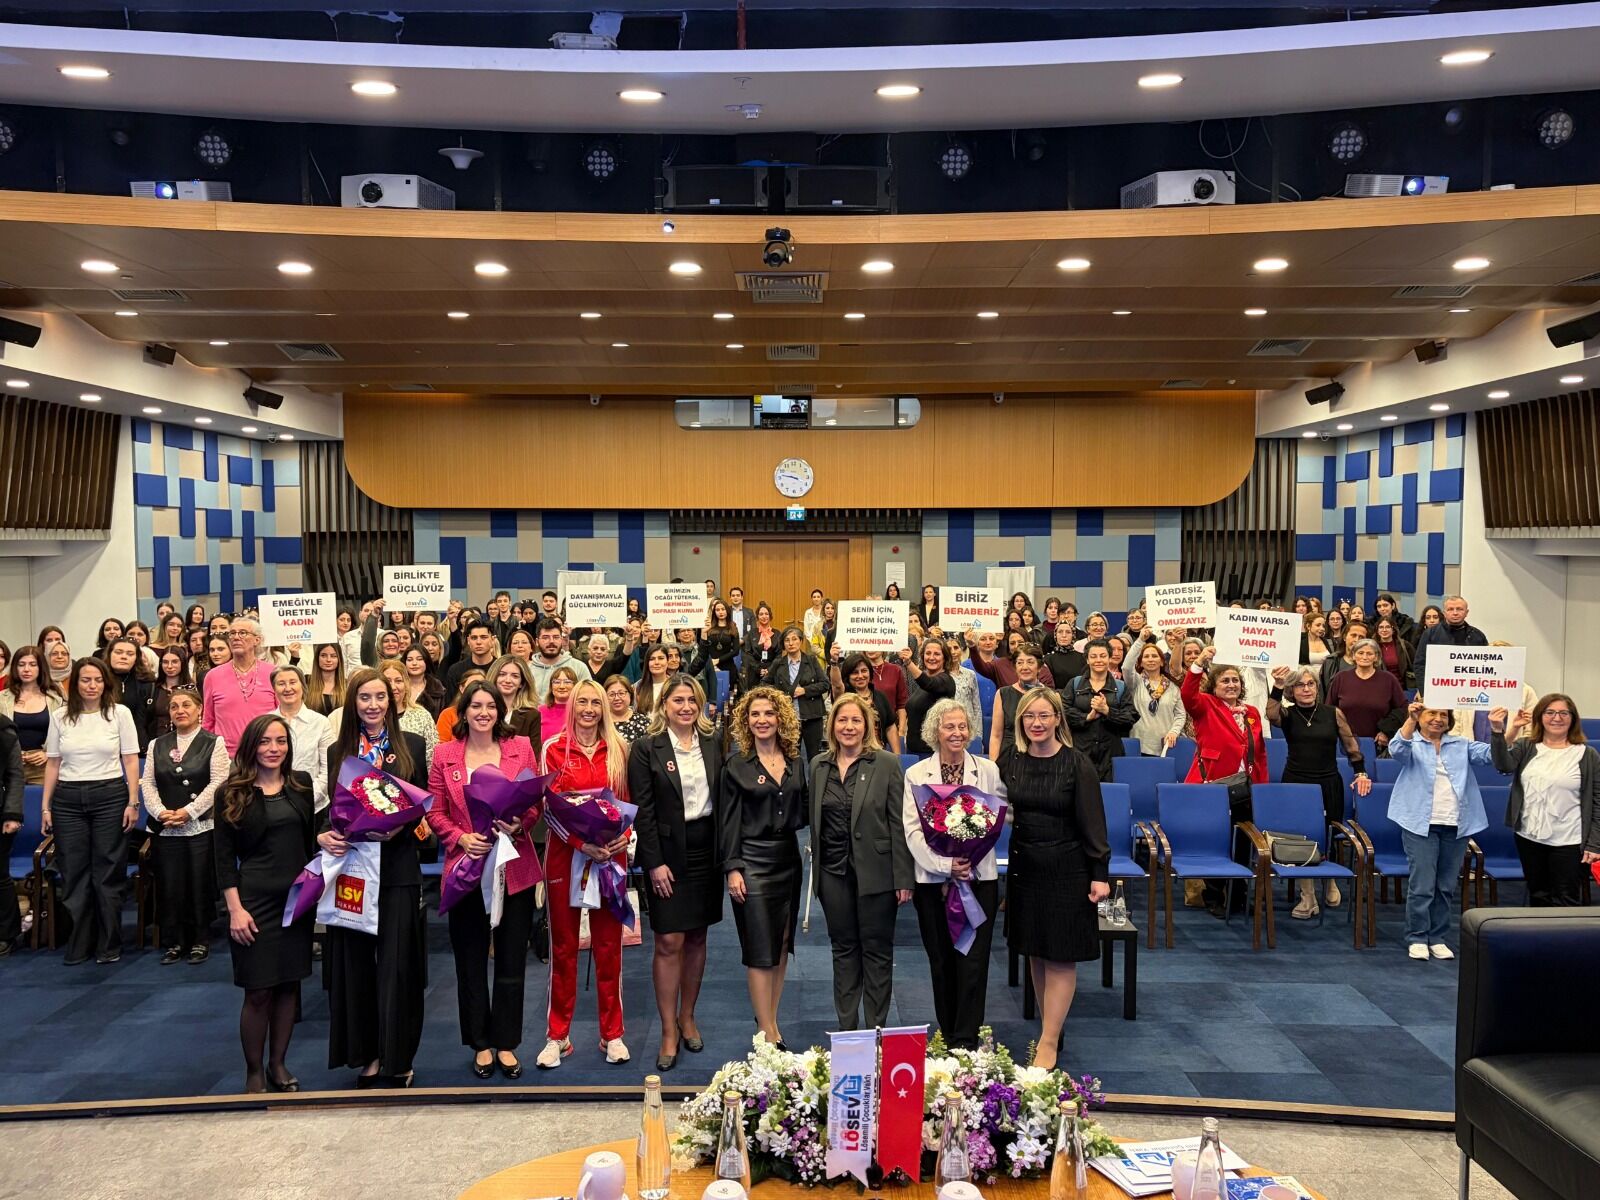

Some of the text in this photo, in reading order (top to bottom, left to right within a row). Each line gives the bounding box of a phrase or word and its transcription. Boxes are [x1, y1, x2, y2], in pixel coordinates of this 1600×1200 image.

[394, 570, 440, 580] BİRLİKTE
[390, 583, 444, 594] GÜÇLÜYÜZ
[1155, 585, 1206, 596] KARDEŞİZ,
[272, 596, 322, 607] EMEĞİYLE
[956, 591, 988, 602] BİRİZ
[1156, 596, 1206, 606] YOLDAŞIZ,
[278, 608, 318, 616] ÜRETEN
[877, 605, 894, 614] İÇİN,
[944, 607, 999, 616] BERABERİZ
[1168, 607, 1196, 615] OMUZ
[877, 616, 895, 624] İÇİN,
[1158, 617, 1206, 626] OMUZAYIZ
[1229, 614, 1290, 625] KADIN VARSA
[1242, 626, 1275, 636] HAYAT
[1239, 638, 1276, 648] VARDIR
[1449, 652, 1503, 662] DAYANIŞMA
[1454, 665, 1496, 675] EKELİM,
[1432, 678, 1517, 689] UMUT BİÇELİM
[667, 761, 675, 771] 8
[338, 885, 362, 903] LSV
[862, 1092, 870, 1122] Çocuklar
[845, 1097, 860, 1151] LÖSEV
[861, 1124, 869, 1151] Lösemili
